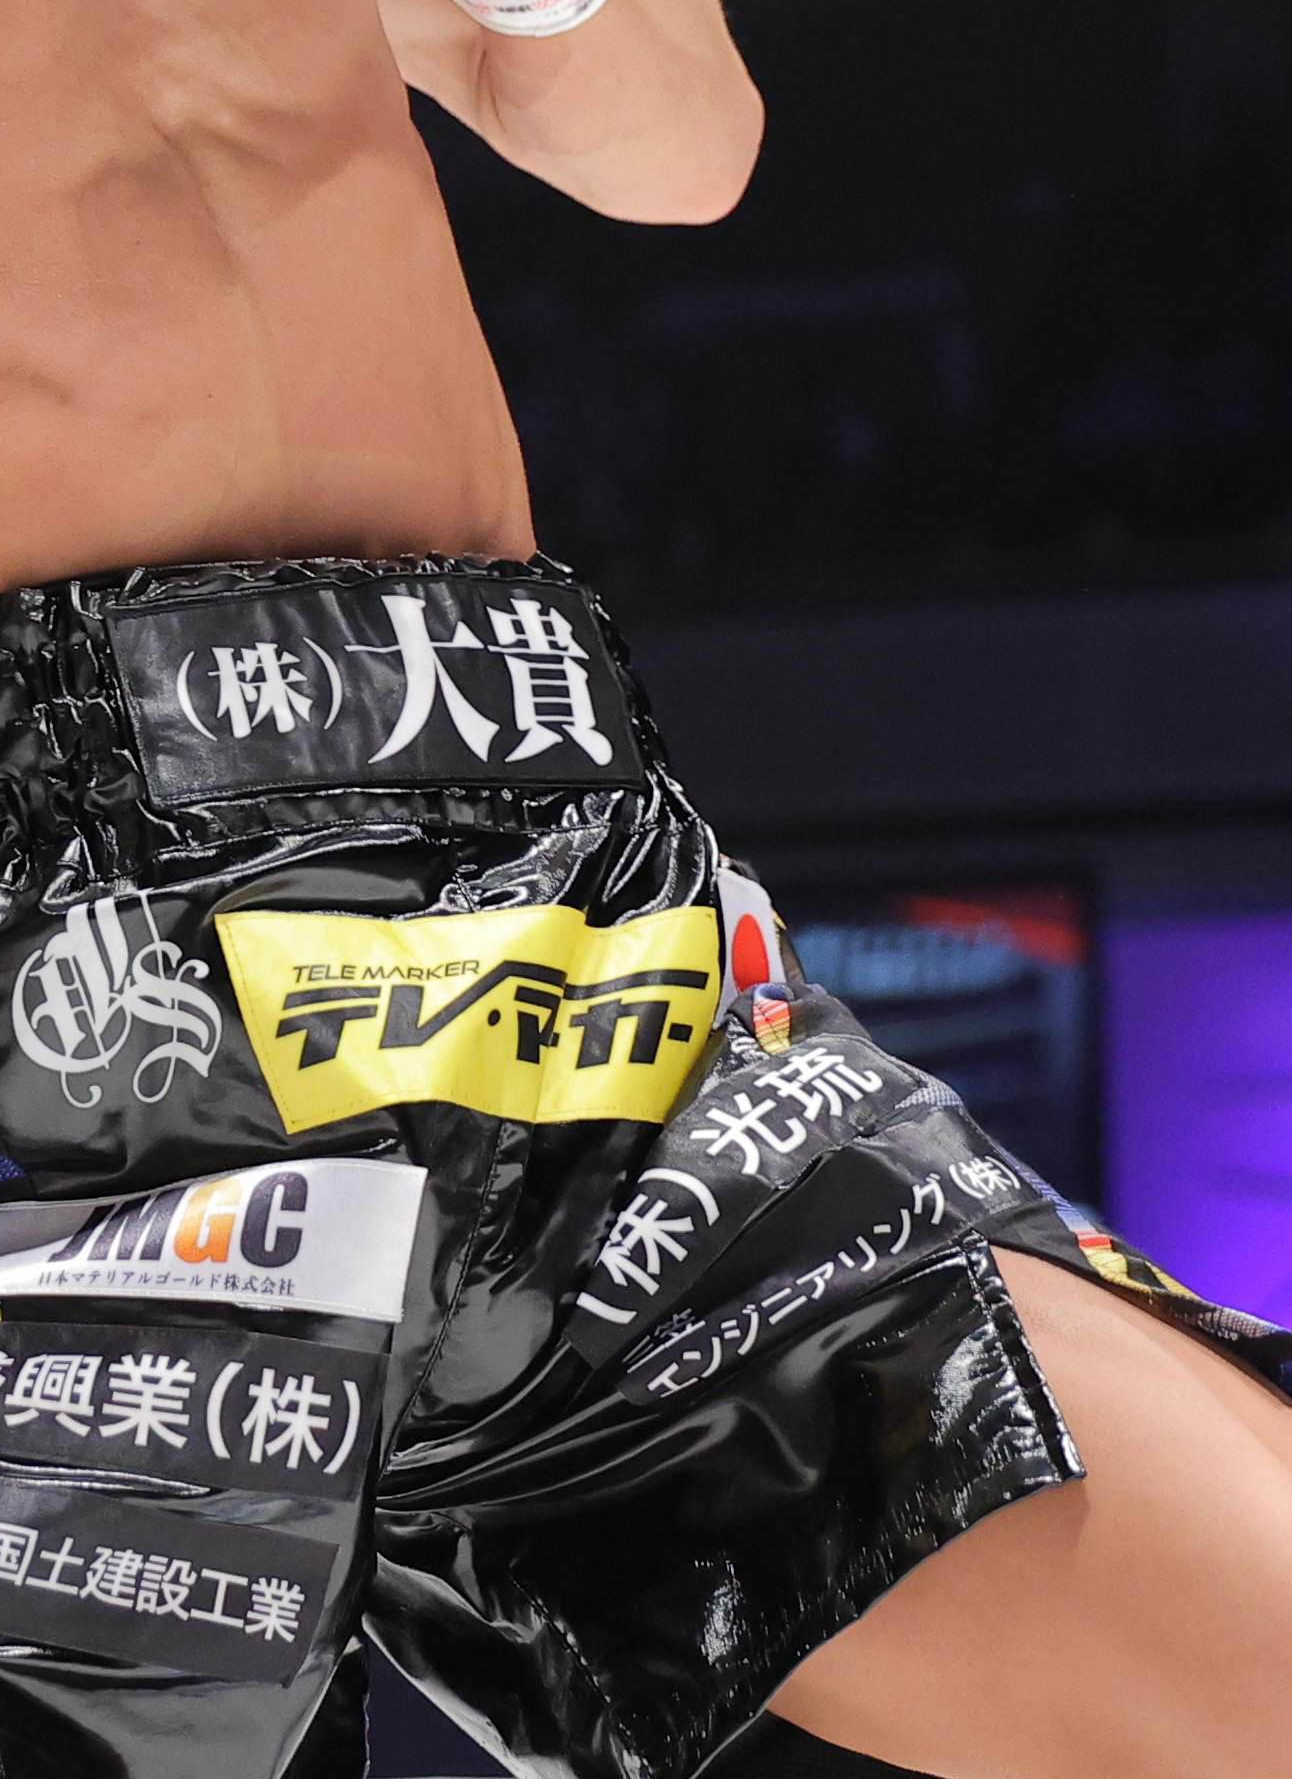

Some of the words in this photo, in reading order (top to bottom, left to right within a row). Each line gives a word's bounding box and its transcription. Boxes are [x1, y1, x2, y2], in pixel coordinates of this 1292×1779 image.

[292, 963, 357, 984] TELE
[361, 959, 481, 981] MARKER
[46, 1171, 309, 1268] JMGC
